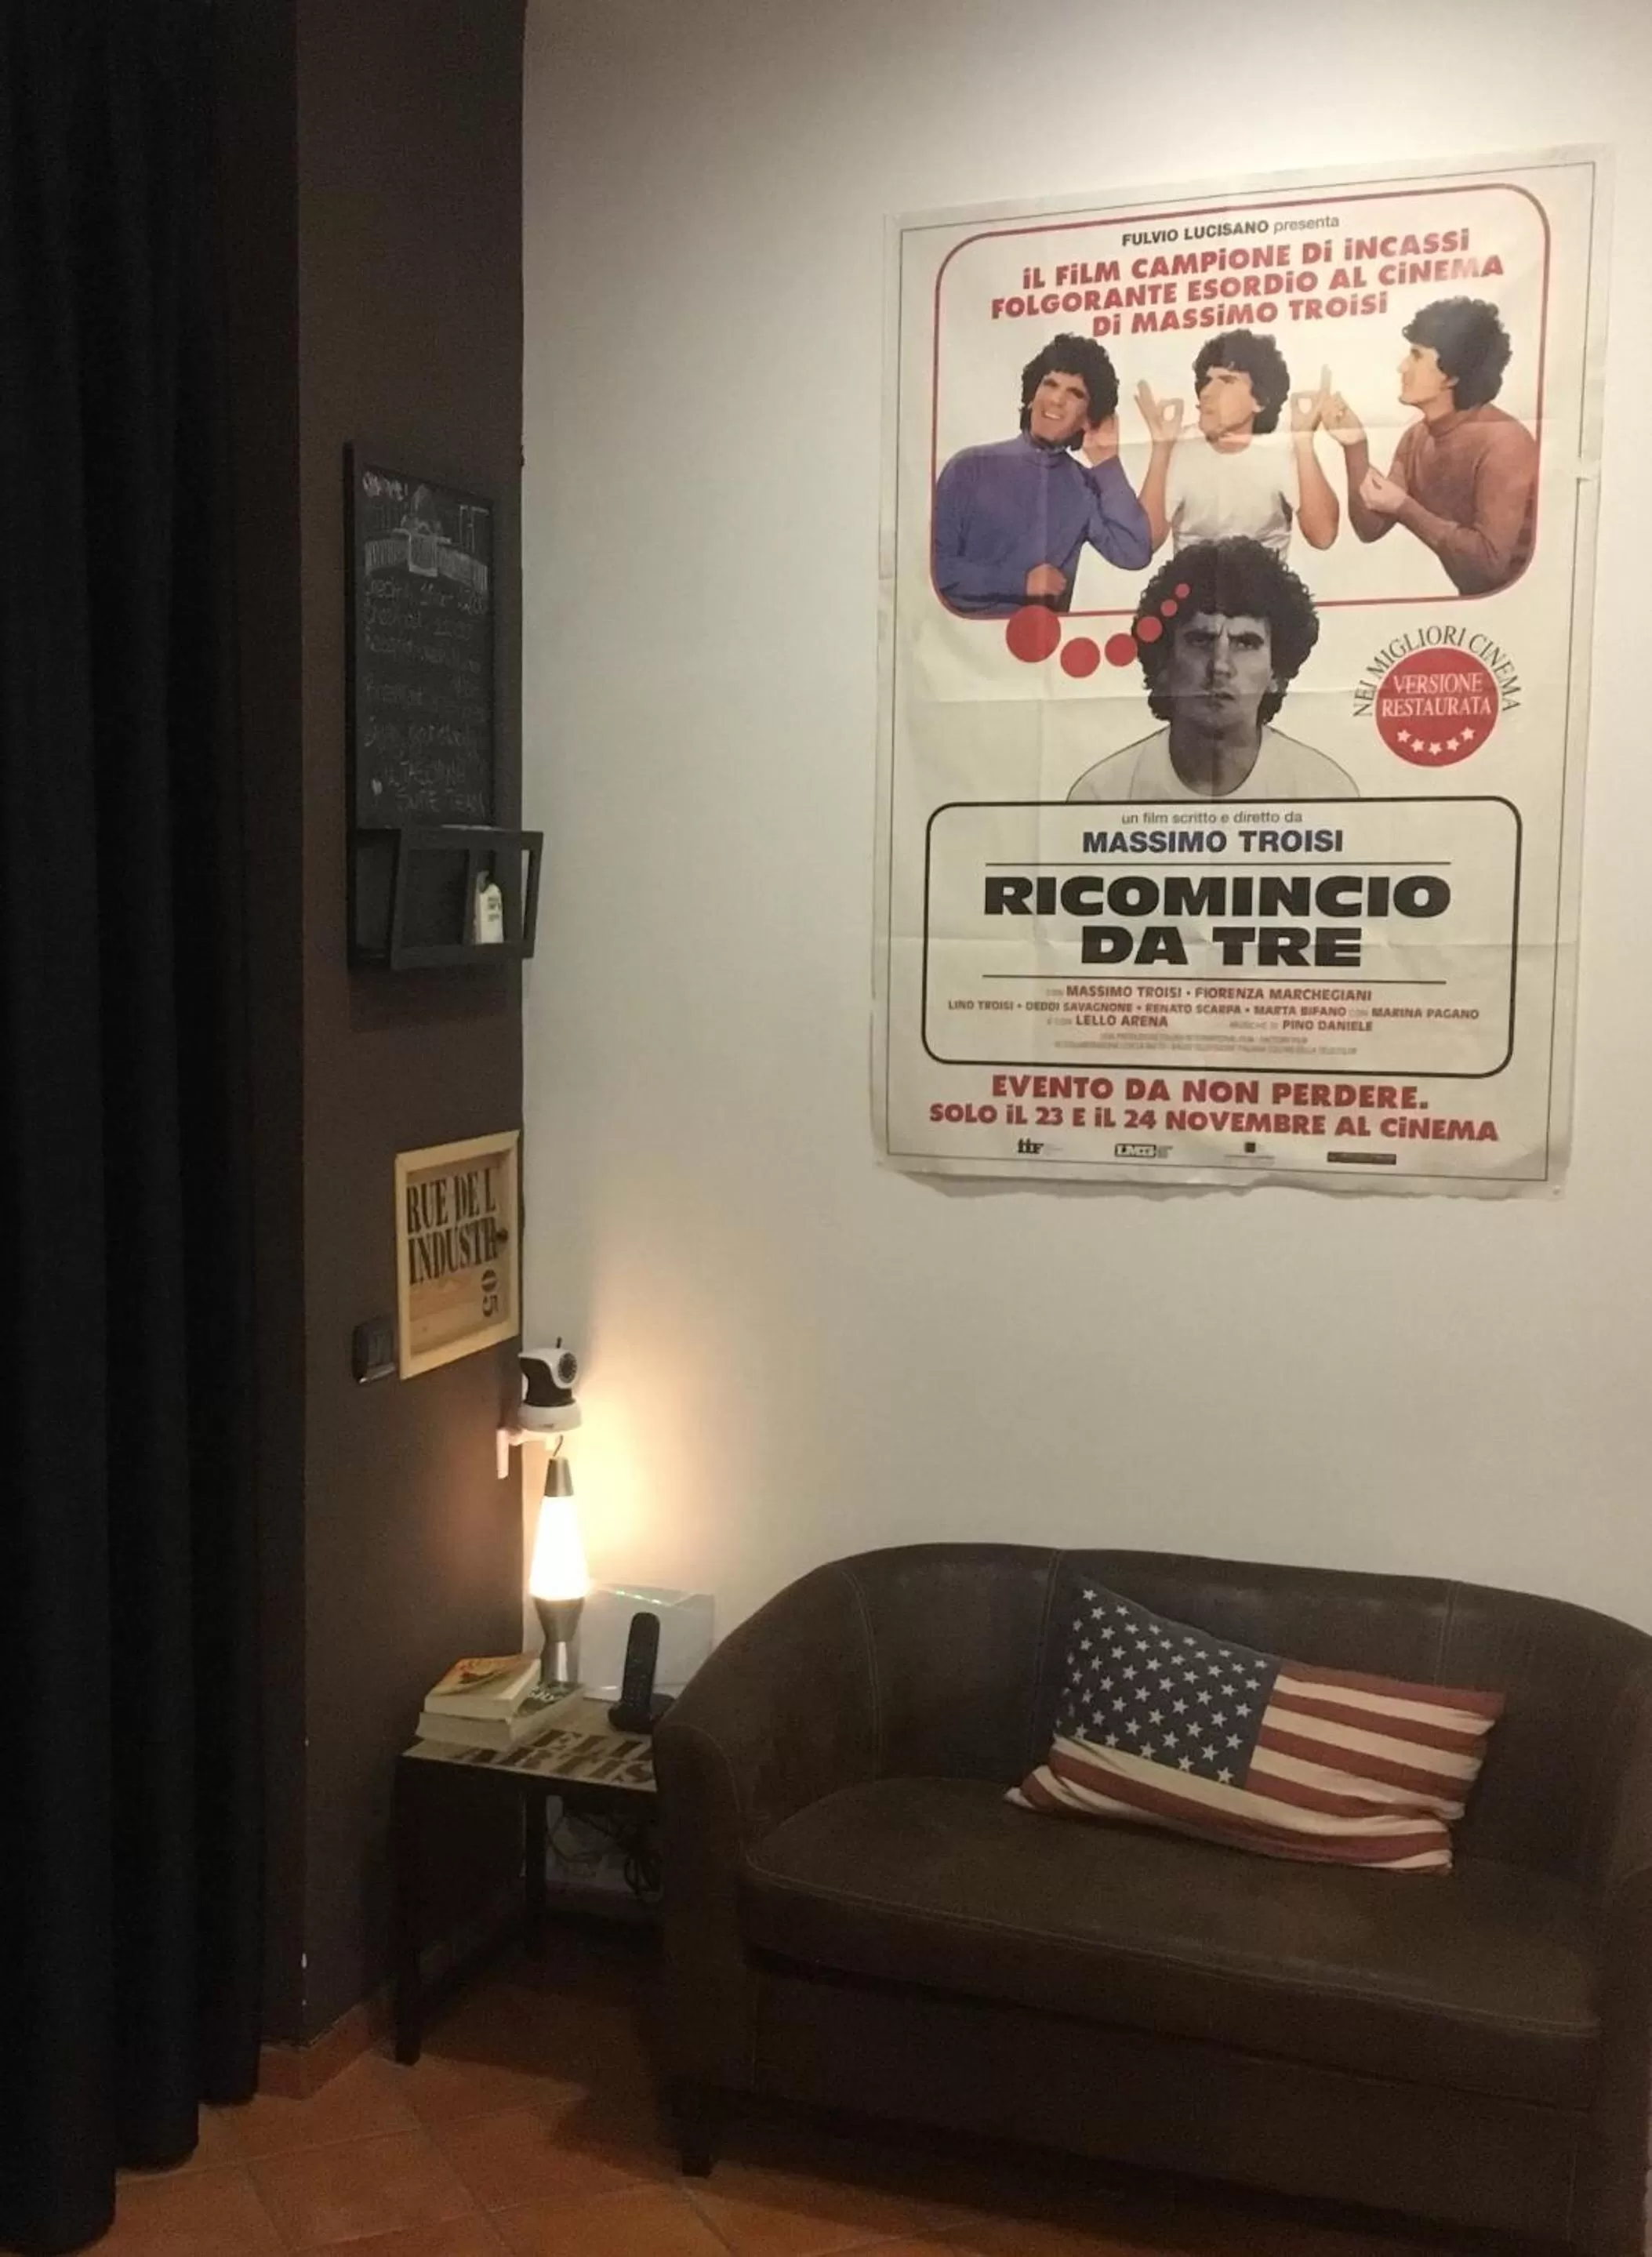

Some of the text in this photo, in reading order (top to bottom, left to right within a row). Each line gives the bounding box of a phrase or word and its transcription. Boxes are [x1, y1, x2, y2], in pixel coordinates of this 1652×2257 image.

[1122, 216, 1340, 246] FULVIO LUCISANO presenta
[991, 282, 1177, 320] FOLGORANTE
[1329, 267, 1367, 289] AL
[1352, 626, 1521, 717] NEI MIGLIORI CINEMA
[1392, 672, 1483, 695] VERSIONE
[1382, 696, 1492, 717] RESTAURATA
[1121, 811, 1302, 825] un film scritto e diretto da
[1083, 829, 1343, 853] MASSIMO TROISI
[984, 875, 1451, 918] RICOMINCIO
[1081, 926, 1363, 967] DA TRE
[1066, 985, 1132, 998] MASSIMO
[1138, 986, 1182, 998] TROISI
[1194, 987, 1264, 1000] FIORENZA
[1269, 989, 1372, 1001] MARCHEGIANI
[948, 1000, 975, 1011] LINO
[978, 1000, 1014, 1011] TROISI
[1062, 1002, 1133, 1013] SAVAGNONE
[1145, 1003, 1192, 1014] RENATO
[1196, 1003, 1242, 1014] SCARPA
[1254, 1005, 1296, 1016] MARTA
[1371, 1007, 1422, 1018] MARINA
[1427, 1008, 1480, 1019] PAGANO
[1075, 1014, 1116, 1026] LELLO
[1120, 1015, 1168, 1027] ARENA
[1283, 1019, 1314, 1030] PINO
[1318, 1020, 1373, 1032] DANIELE
[992, 1074, 1429, 1109] EVENTO DA NON PERDERE.
[929, 1102, 997, 1123] SOLO
[1035, 1106, 1063, 1126] 23
[1072, 1107, 1086, 1127] E
[1124, 1109, 1157, 1130] 24
[1165, 1110, 1326, 1134] NOVEMBRE
[1334, 1116, 1371, 1137] AL
[406, 1178, 449, 1234] RUE
[453, 1171, 480, 1219] DE
